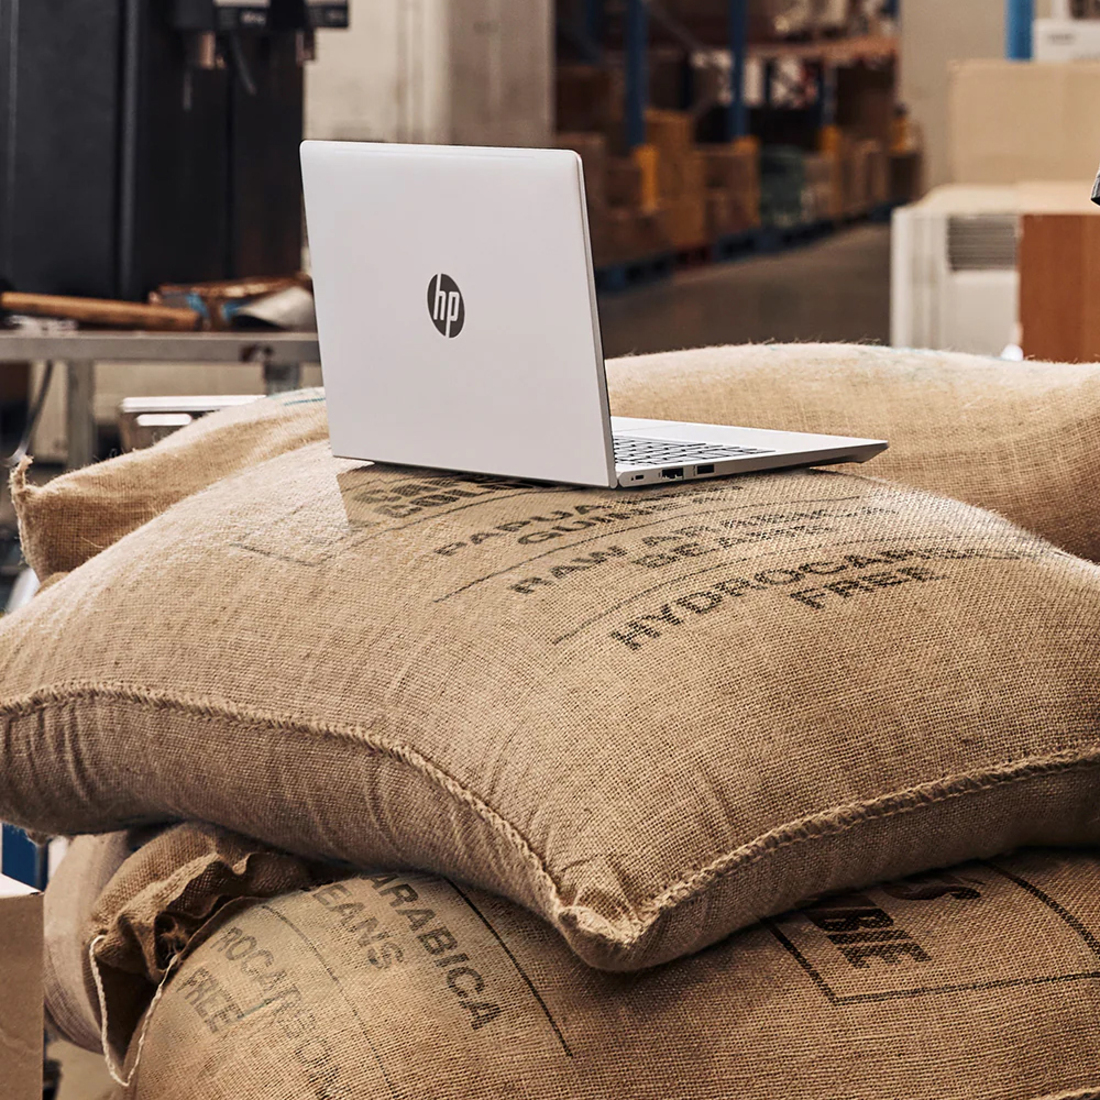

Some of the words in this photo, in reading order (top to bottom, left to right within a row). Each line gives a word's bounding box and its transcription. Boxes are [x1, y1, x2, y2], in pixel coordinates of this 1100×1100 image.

[432, 273, 460, 338] hp
[508, 545, 627, 595] RAW
[790, 567, 948, 611] FREE
[312, 884, 404, 970] EANS
